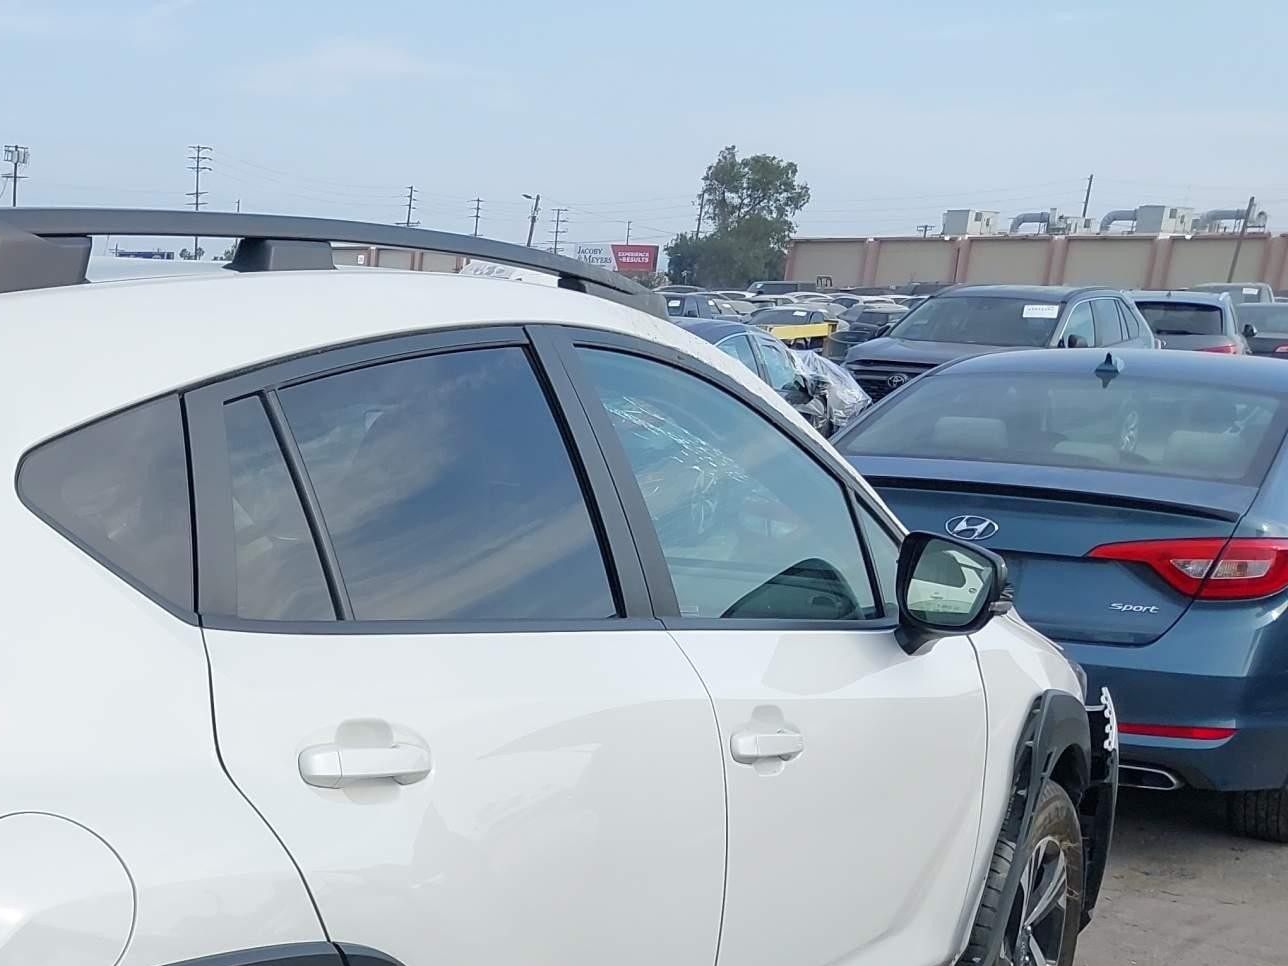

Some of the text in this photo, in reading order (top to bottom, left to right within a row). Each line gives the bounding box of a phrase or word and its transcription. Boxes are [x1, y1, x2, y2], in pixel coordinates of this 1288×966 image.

[577, 246, 603, 255] JACOBY
[584, 254, 612, 264] MEYERS
[1108, 603, 1160, 614] Sport
